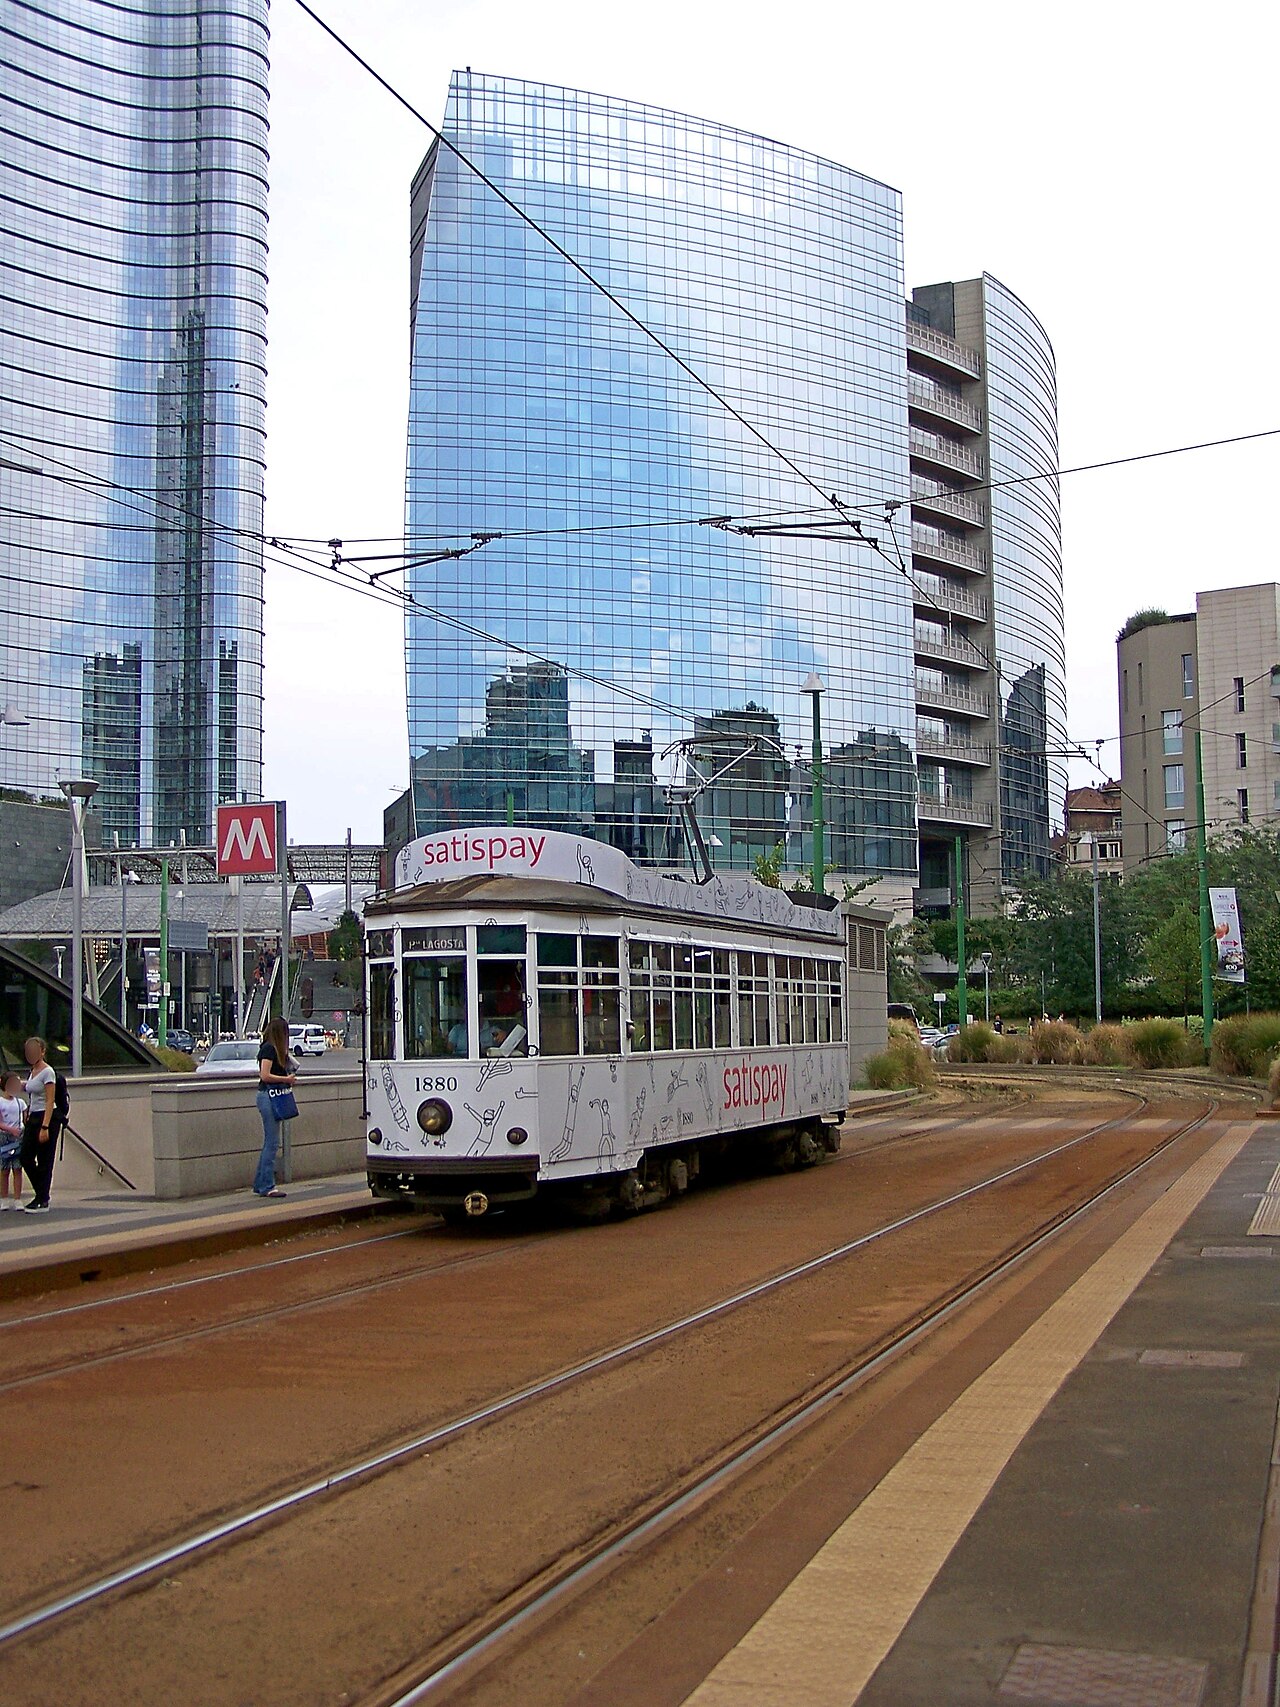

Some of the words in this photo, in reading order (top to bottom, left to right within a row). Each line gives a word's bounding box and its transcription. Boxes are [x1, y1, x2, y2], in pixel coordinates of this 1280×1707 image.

[221, 817, 273, 861] M
[423, 833, 546, 869] satispay
[422, 939, 464, 950] LAGOSTA
[415, 1076, 457, 1092] 1880
[723, 1053, 787, 1121] satispay
